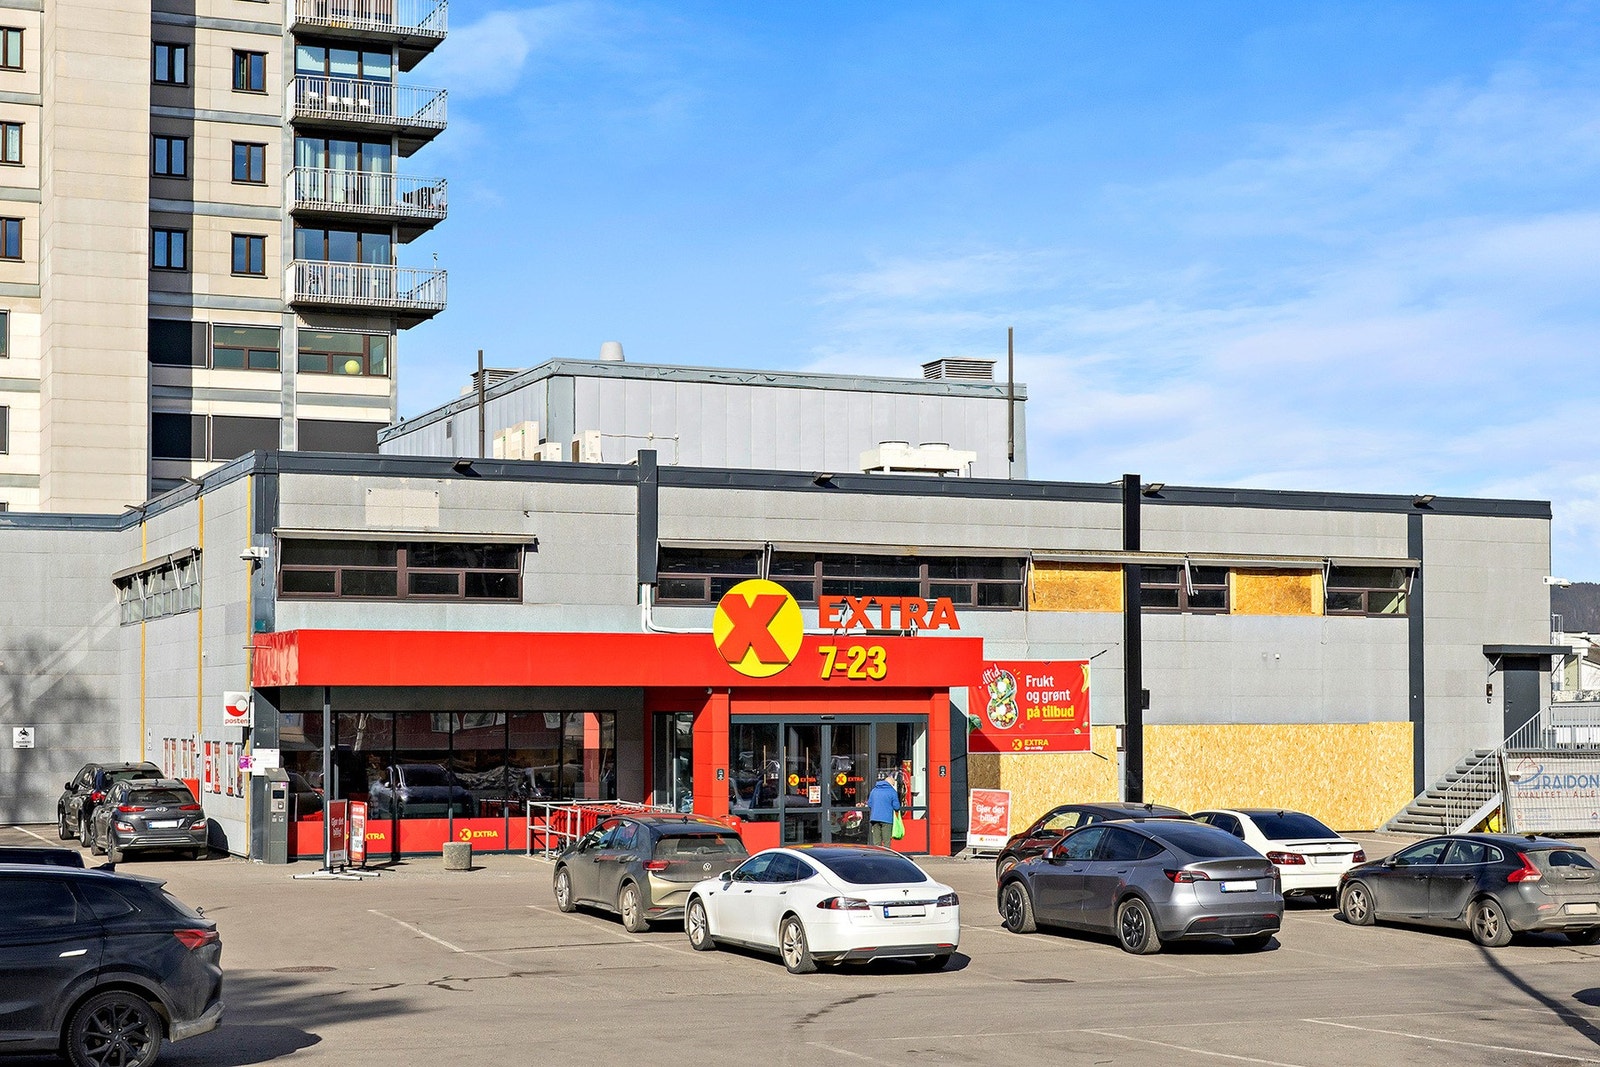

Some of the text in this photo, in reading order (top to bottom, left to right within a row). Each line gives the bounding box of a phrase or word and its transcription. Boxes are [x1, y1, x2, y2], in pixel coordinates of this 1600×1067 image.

[819, 595, 960, 630] EXTRA
[818, 646, 888, 679] 7-23
[1026, 675, 1054, 687] Frukt
[1026, 690, 1070, 704] og grønt
[1027, 705, 1075, 720] på tilbud
[1542, 774, 1600, 789] RAIDON
[1573, 790, 1595, 798] ALLE
